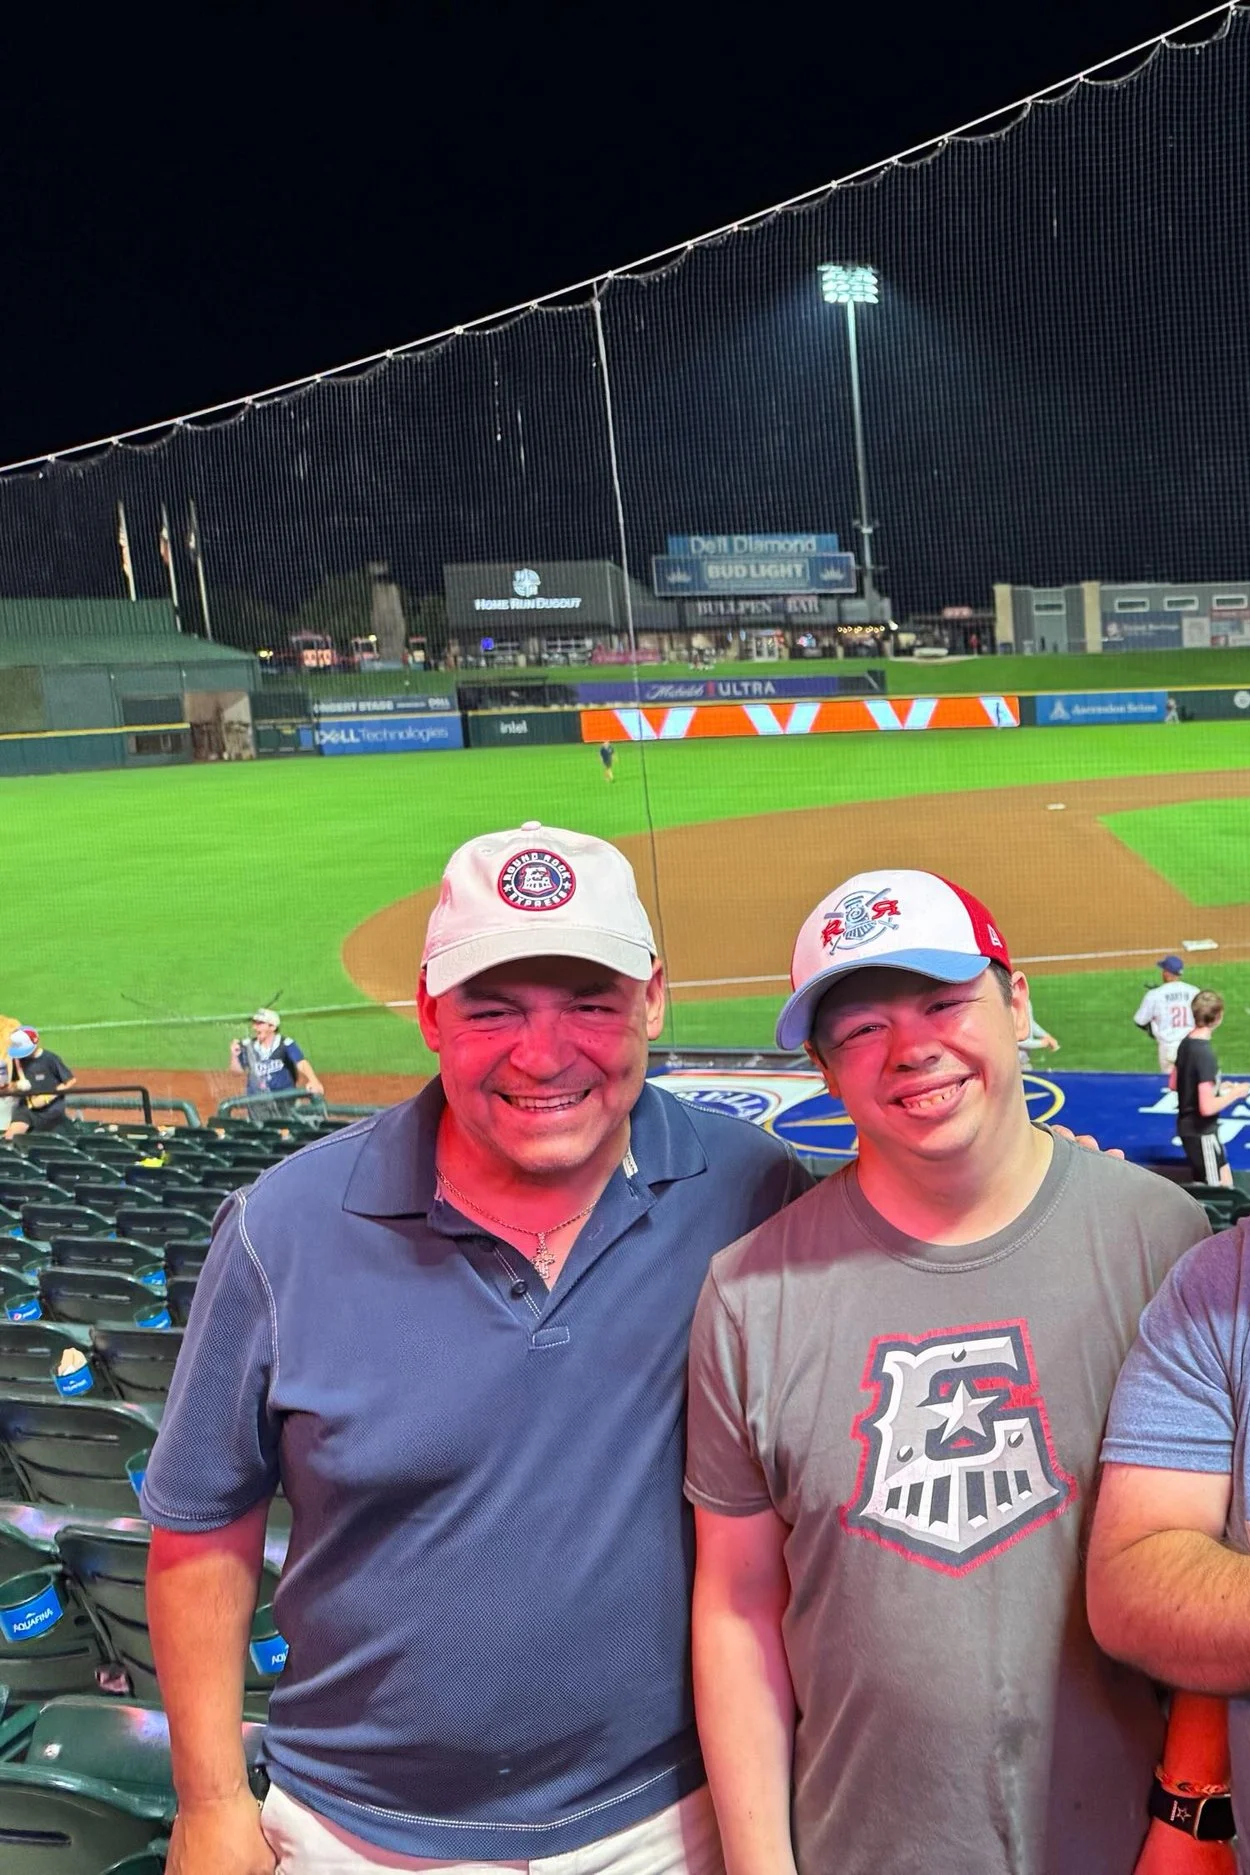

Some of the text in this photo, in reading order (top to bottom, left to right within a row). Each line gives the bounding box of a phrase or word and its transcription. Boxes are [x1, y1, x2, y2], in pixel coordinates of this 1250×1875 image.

[690, 535, 817, 554] Dell Diamond
[708, 563, 804, 579] BUD LIGHT
[698, 598, 820, 616] BULLPEN BAR
[718, 680, 776, 697] ULTRA
[314, 725, 449, 745] DELL Technologies
[500, 720, 528, 734] intel
[503, 852, 572, 881] ROUND ROCK
[508, 890, 568, 908] EXPRESS
[1171, 1005, 1188, 1028] 21
[13, 1607, 54, 1633] AQUAFINA
